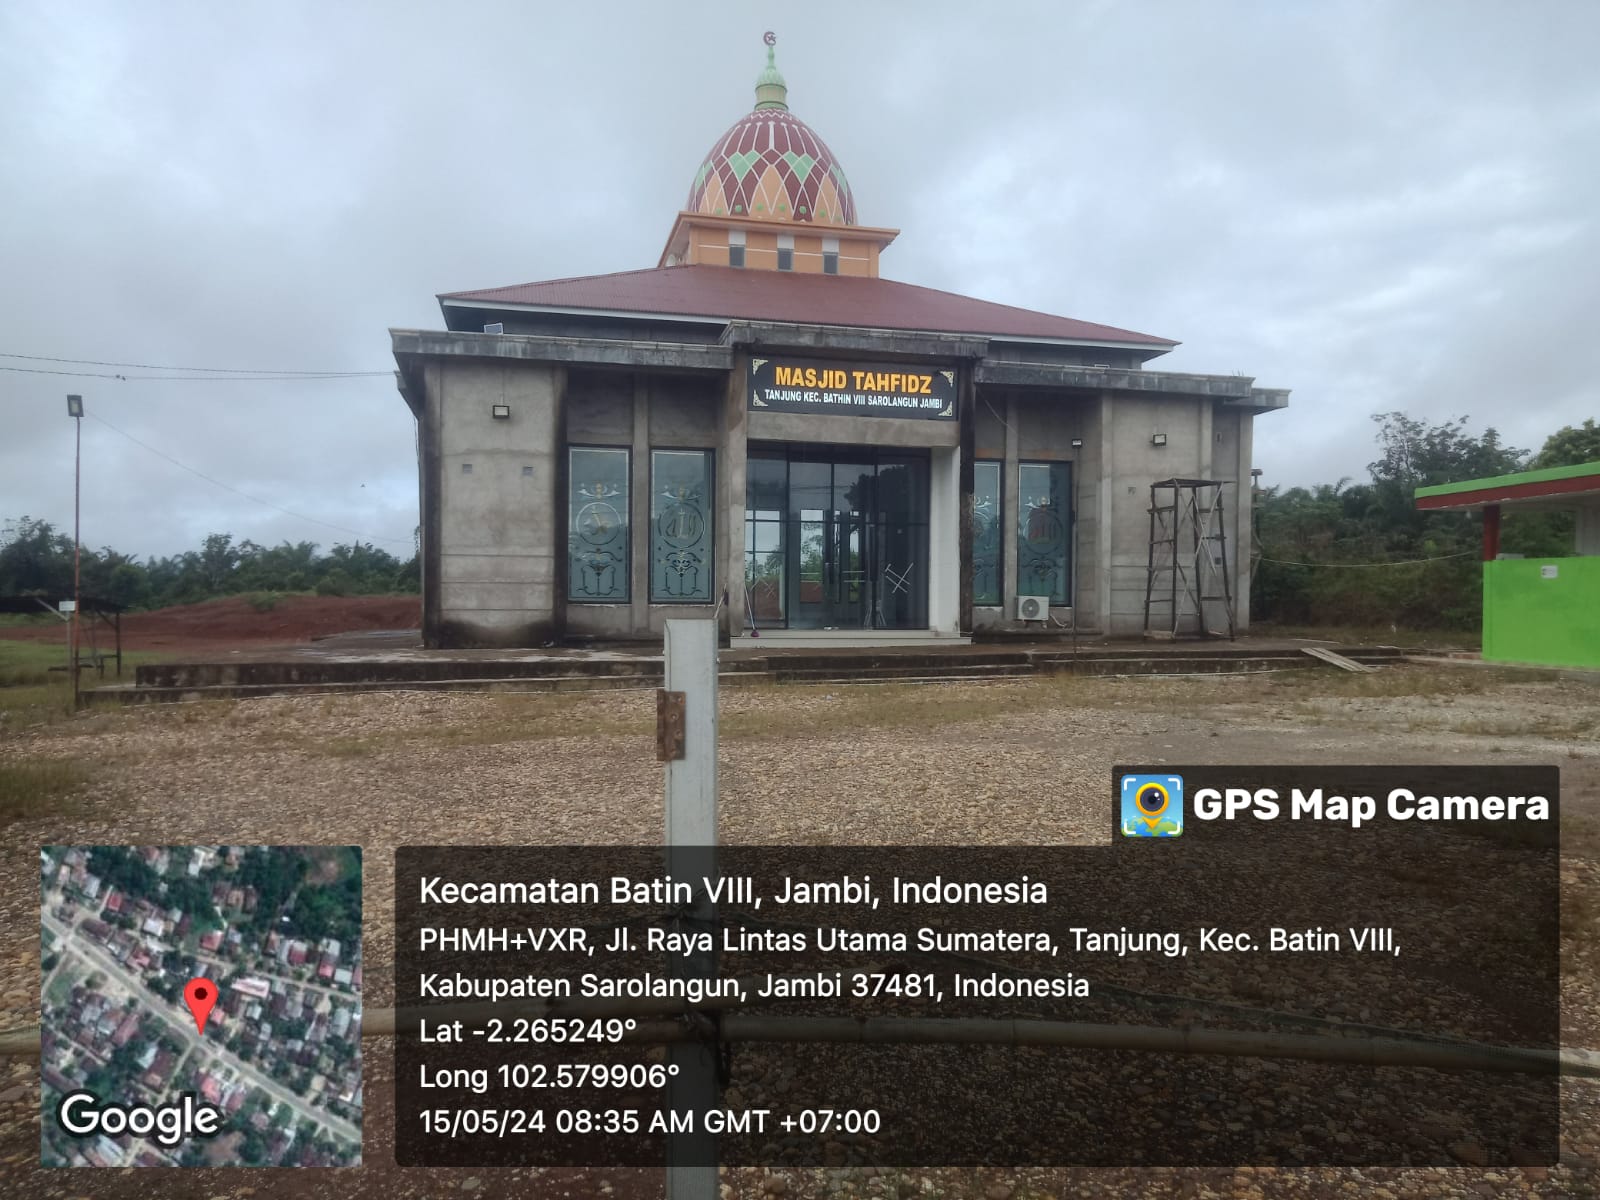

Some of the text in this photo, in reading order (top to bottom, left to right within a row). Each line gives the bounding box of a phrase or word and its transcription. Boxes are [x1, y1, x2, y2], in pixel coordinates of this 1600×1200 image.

[775, 366, 933, 394] MASJID TAHFIDZ
[765, 389, 943, 409] TANJUNG KEC. BATHIN VIII SAROLANGUN JAMBI
